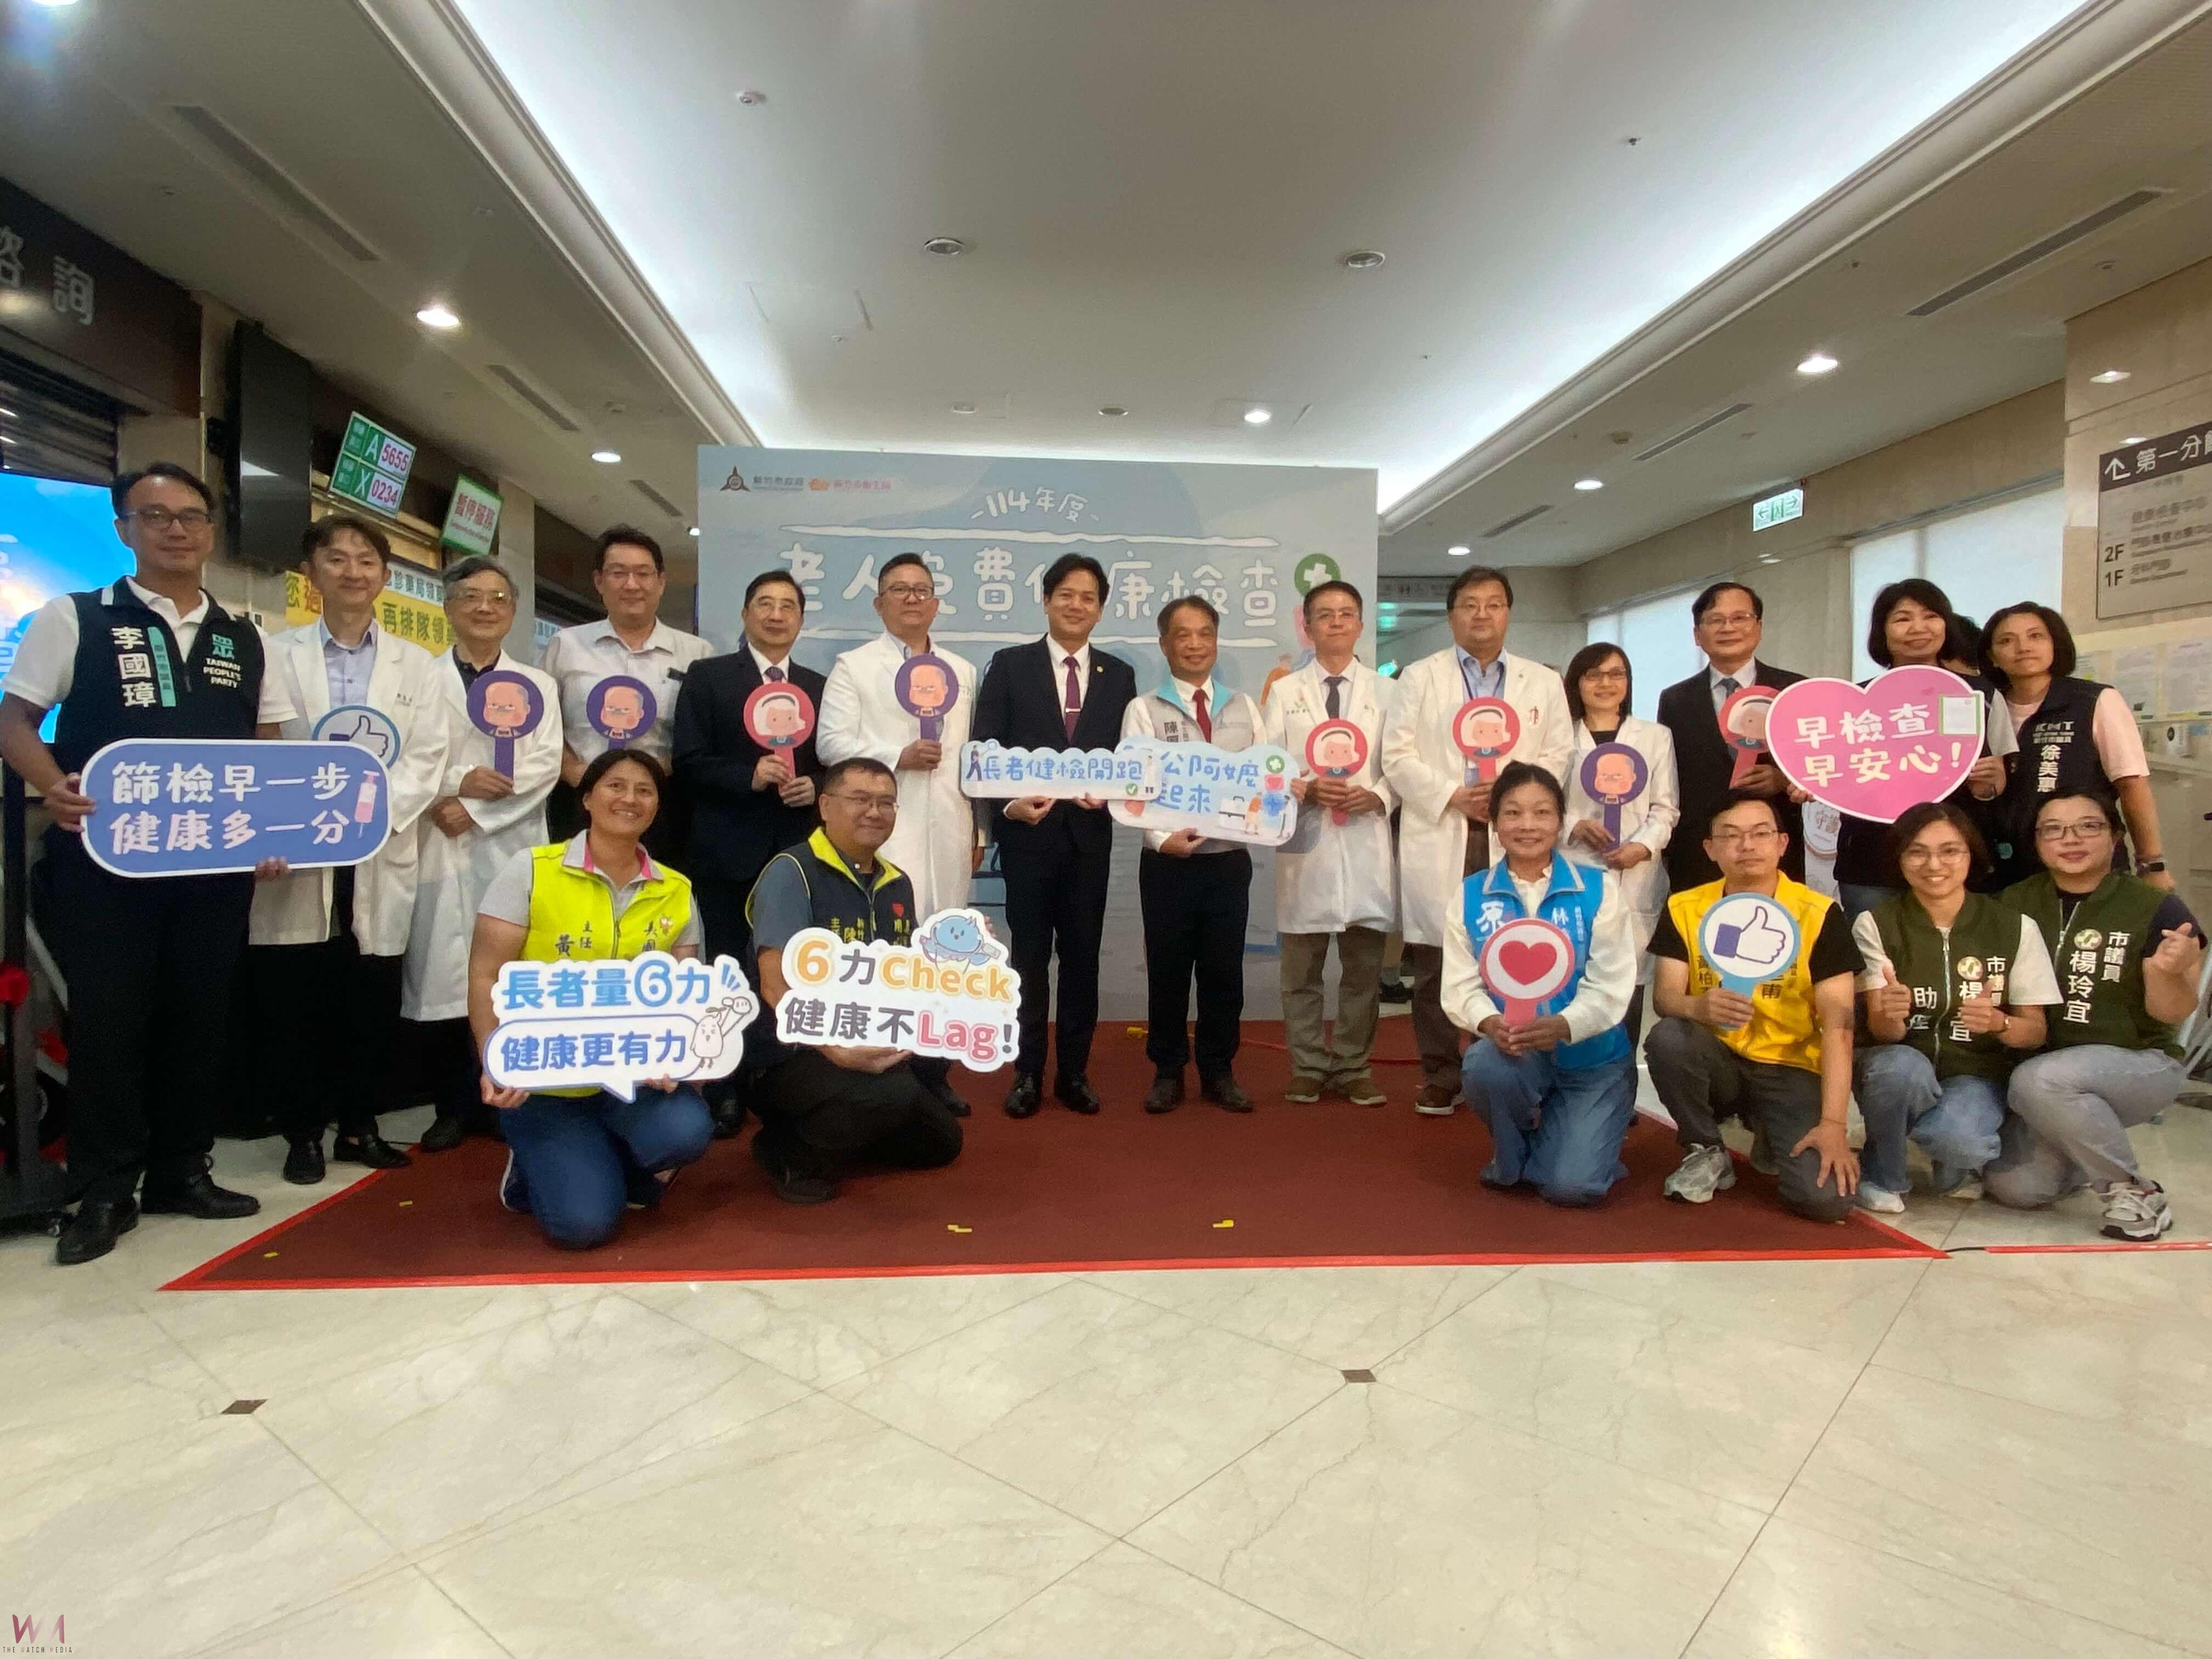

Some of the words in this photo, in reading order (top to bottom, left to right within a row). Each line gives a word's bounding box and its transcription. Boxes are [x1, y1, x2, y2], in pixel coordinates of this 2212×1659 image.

[364, 434, 379, 461] A
[381, 443, 409, 471] 5655
[354, 469, 371, 496] X
[371, 479, 399, 506] 0234
[986, 486, 1089, 523] 114年度
[2104, 543, 2125, 562] 2F
[2105, 569, 2124, 587] 1F
[111, 627, 156, 707] 李國璋
[205, 658, 240, 672] TAIWAN
[211, 676, 238, 688] PARTY
[1794, 703, 1934, 749] 早檢查
[2035, 721, 2074, 732] KMT
[111, 760, 351, 805] 篩檢早一步
[983, 754, 1143, 781] 長者健檢開跑
[1124, 746, 1260, 788] 公阿嬤
[1802, 742, 1962, 788] 早安心!
[110, 810, 349, 855] 健康多一分
[2101, 931, 2131, 983] 市議員
[2063, 950, 2097, 1024] 楊玲宜
[1949, 981, 1983, 1042] 楊宜
[500, 1029, 686, 1073] 健康更有力
